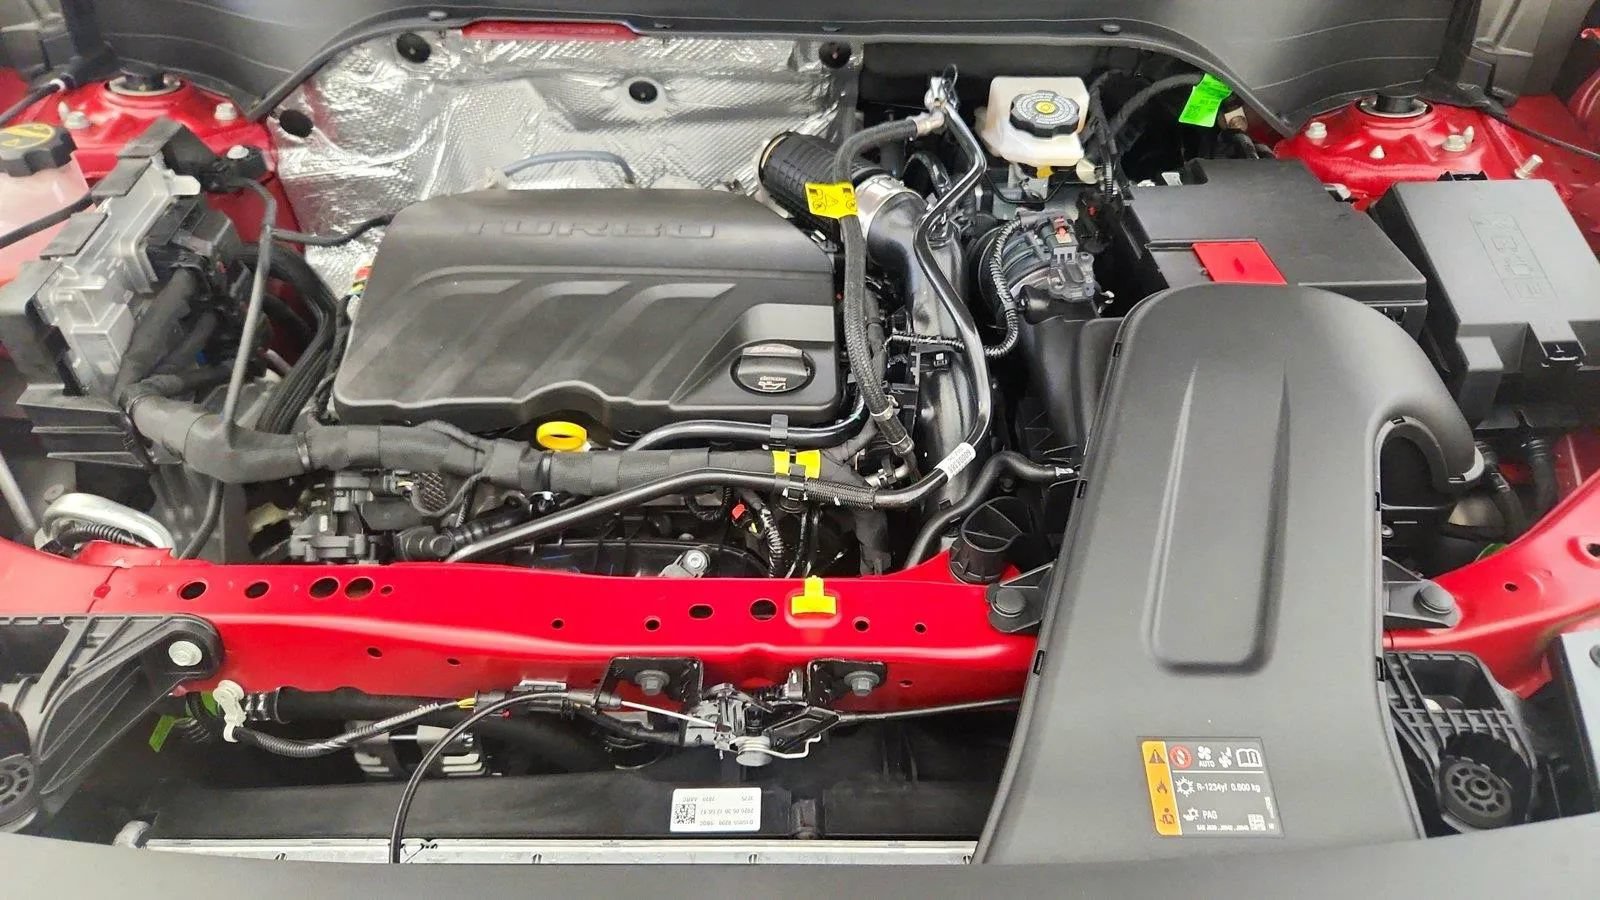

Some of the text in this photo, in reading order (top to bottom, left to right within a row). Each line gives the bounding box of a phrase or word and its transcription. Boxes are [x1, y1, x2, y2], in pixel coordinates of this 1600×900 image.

[466, 220, 716, 239] TURBO
[1199, 760, 1215, 768] AUTO
[1251, 783, 1260, 793] kg
[1202, 810, 1218, 820] PAG
